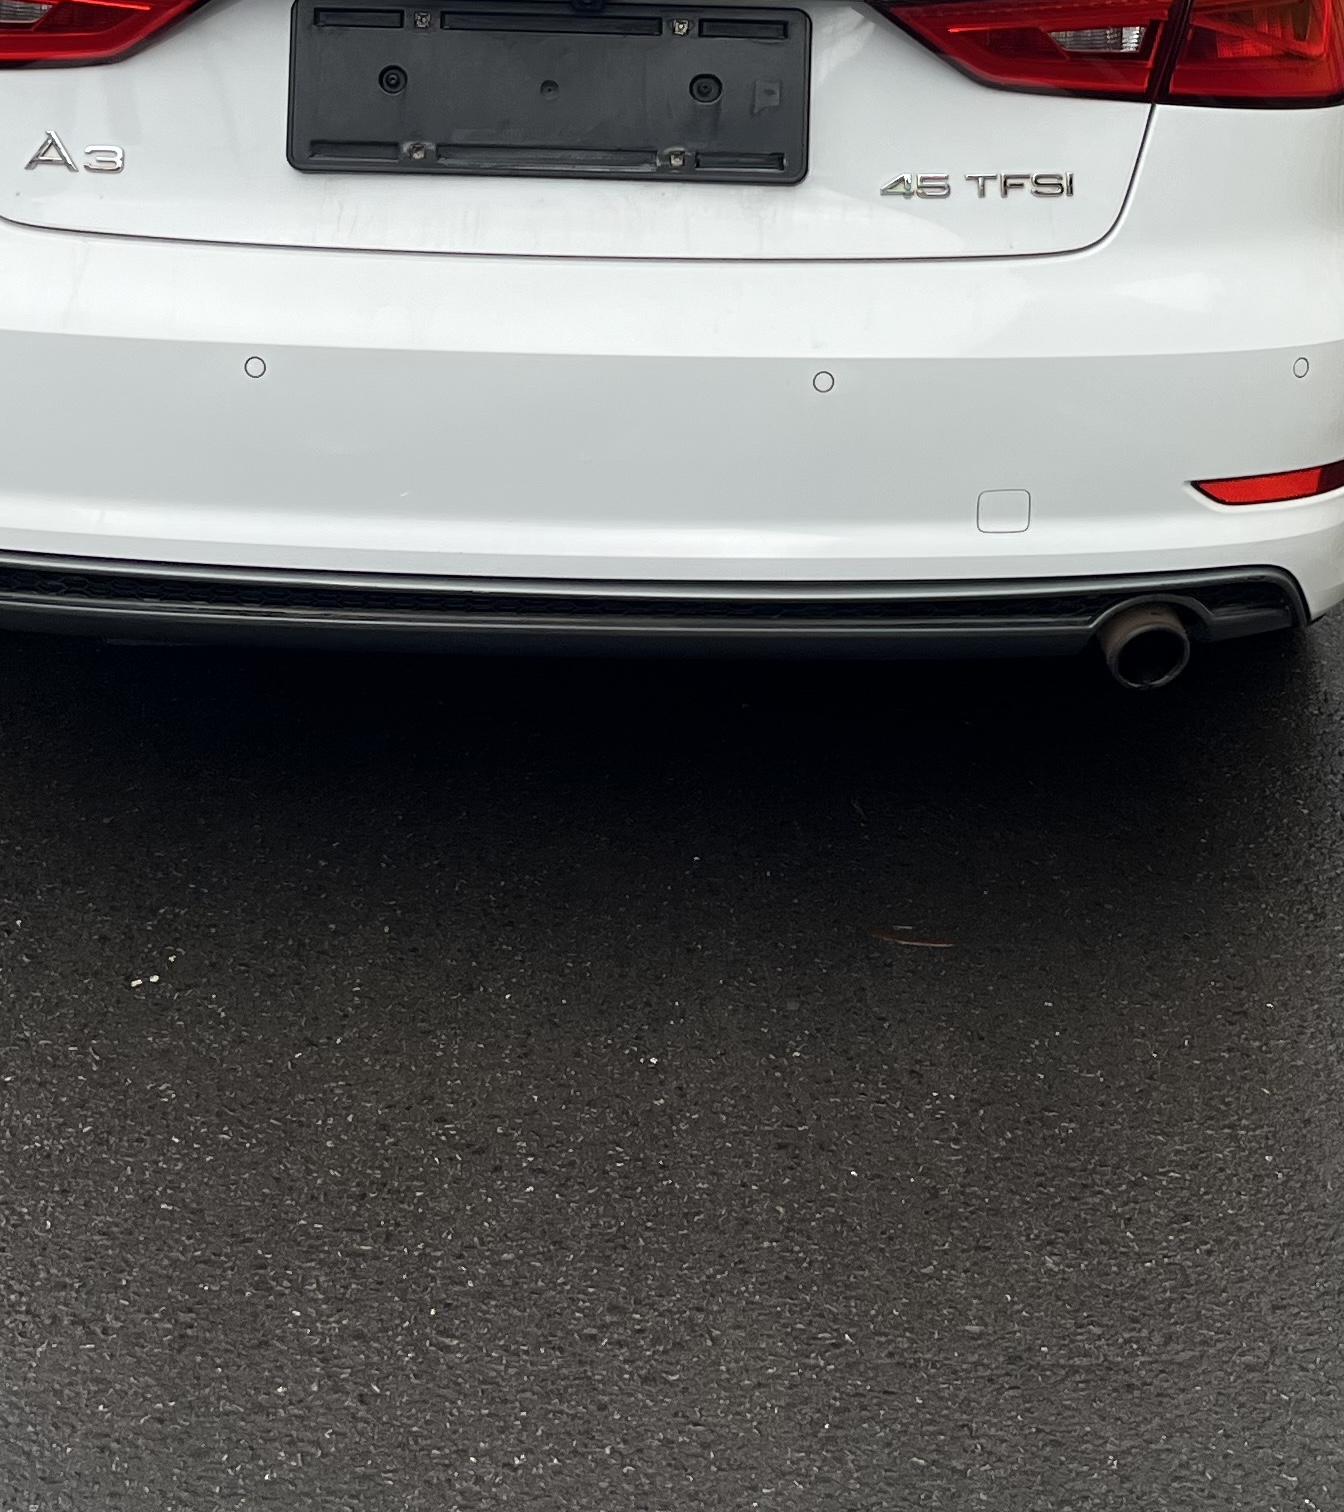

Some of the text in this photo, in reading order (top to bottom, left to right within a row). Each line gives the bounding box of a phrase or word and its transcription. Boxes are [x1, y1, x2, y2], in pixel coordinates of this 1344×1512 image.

[24, 129, 125, 174] A3
[880, 171, 1074, 199] 45 TFSI
